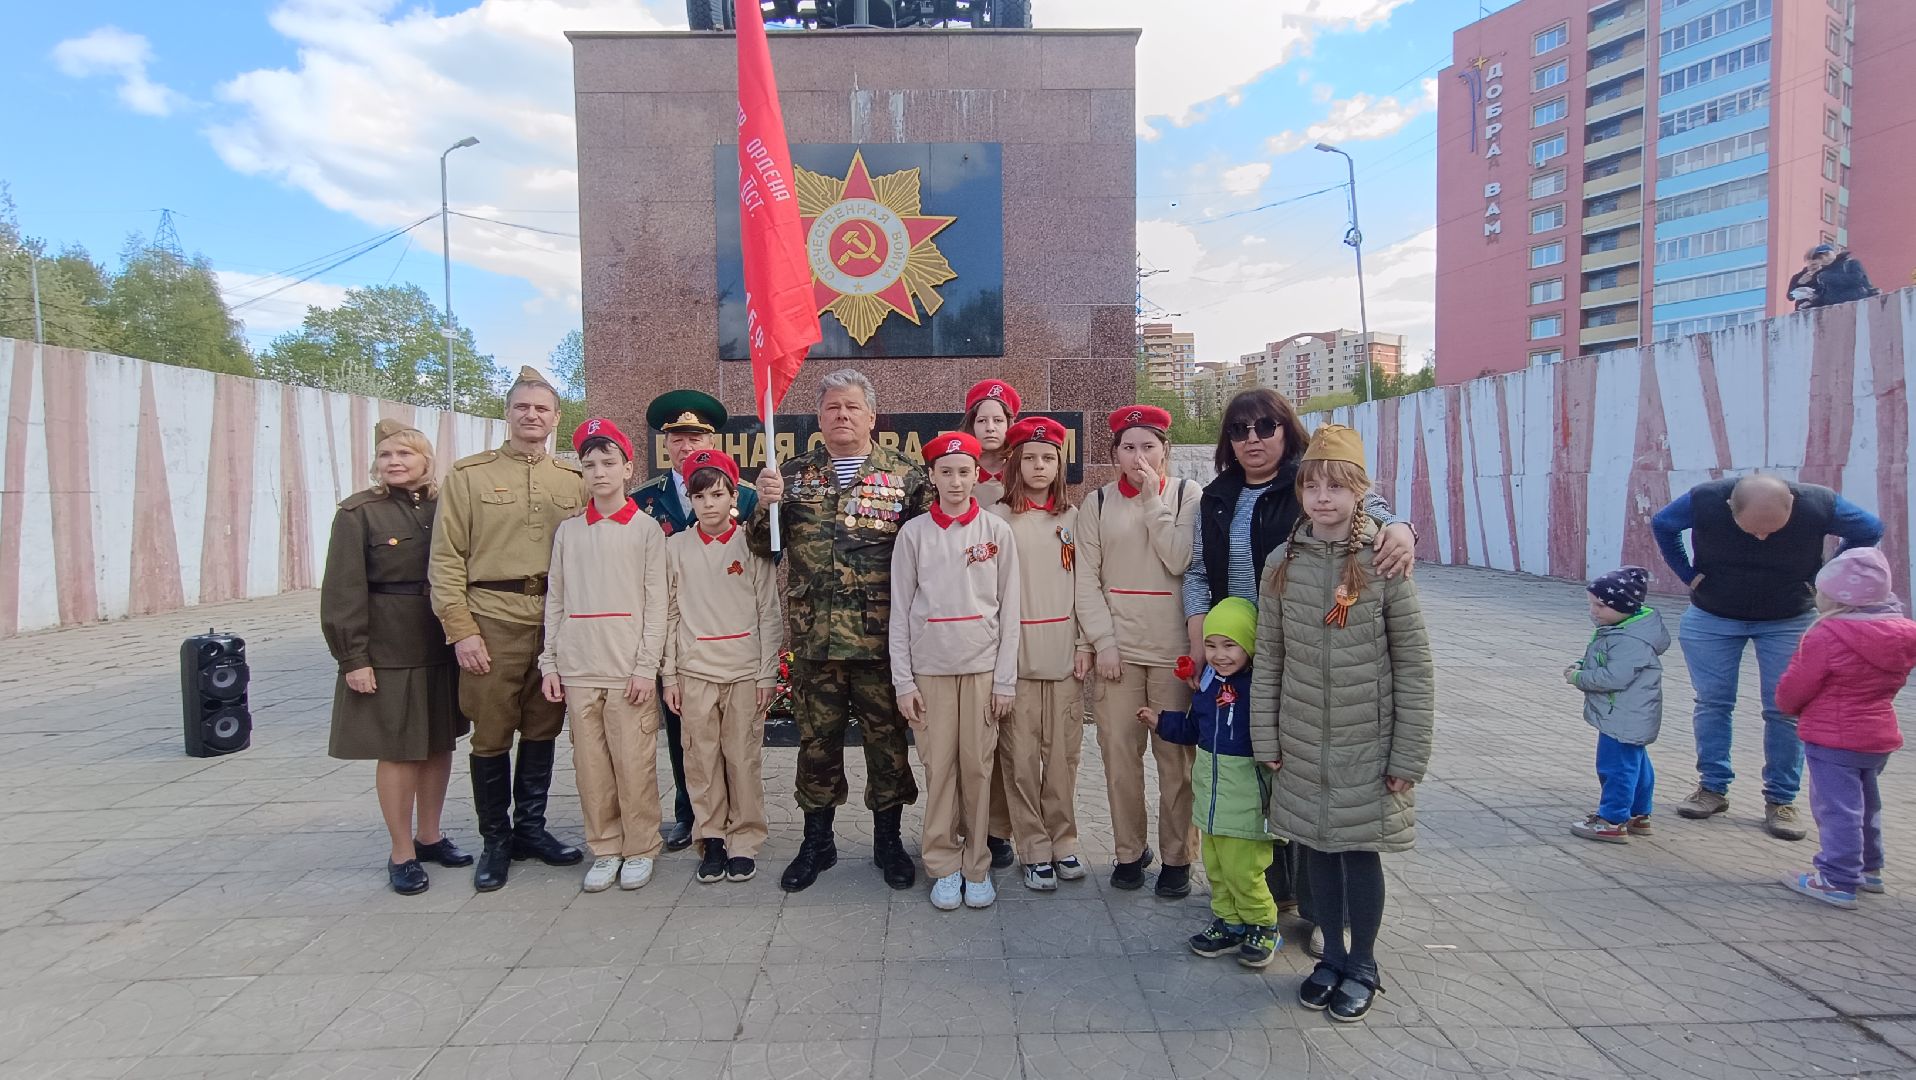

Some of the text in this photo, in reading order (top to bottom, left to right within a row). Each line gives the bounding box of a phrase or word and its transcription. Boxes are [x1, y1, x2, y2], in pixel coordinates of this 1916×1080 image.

[746, 138, 791, 202] ОРДЕНА
[1484, 62, 1503, 237] ДОБРА ВАМ
[812, 203, 906, 281] ОТЕЧЕСТВЕННАЯ ВОЙНА
